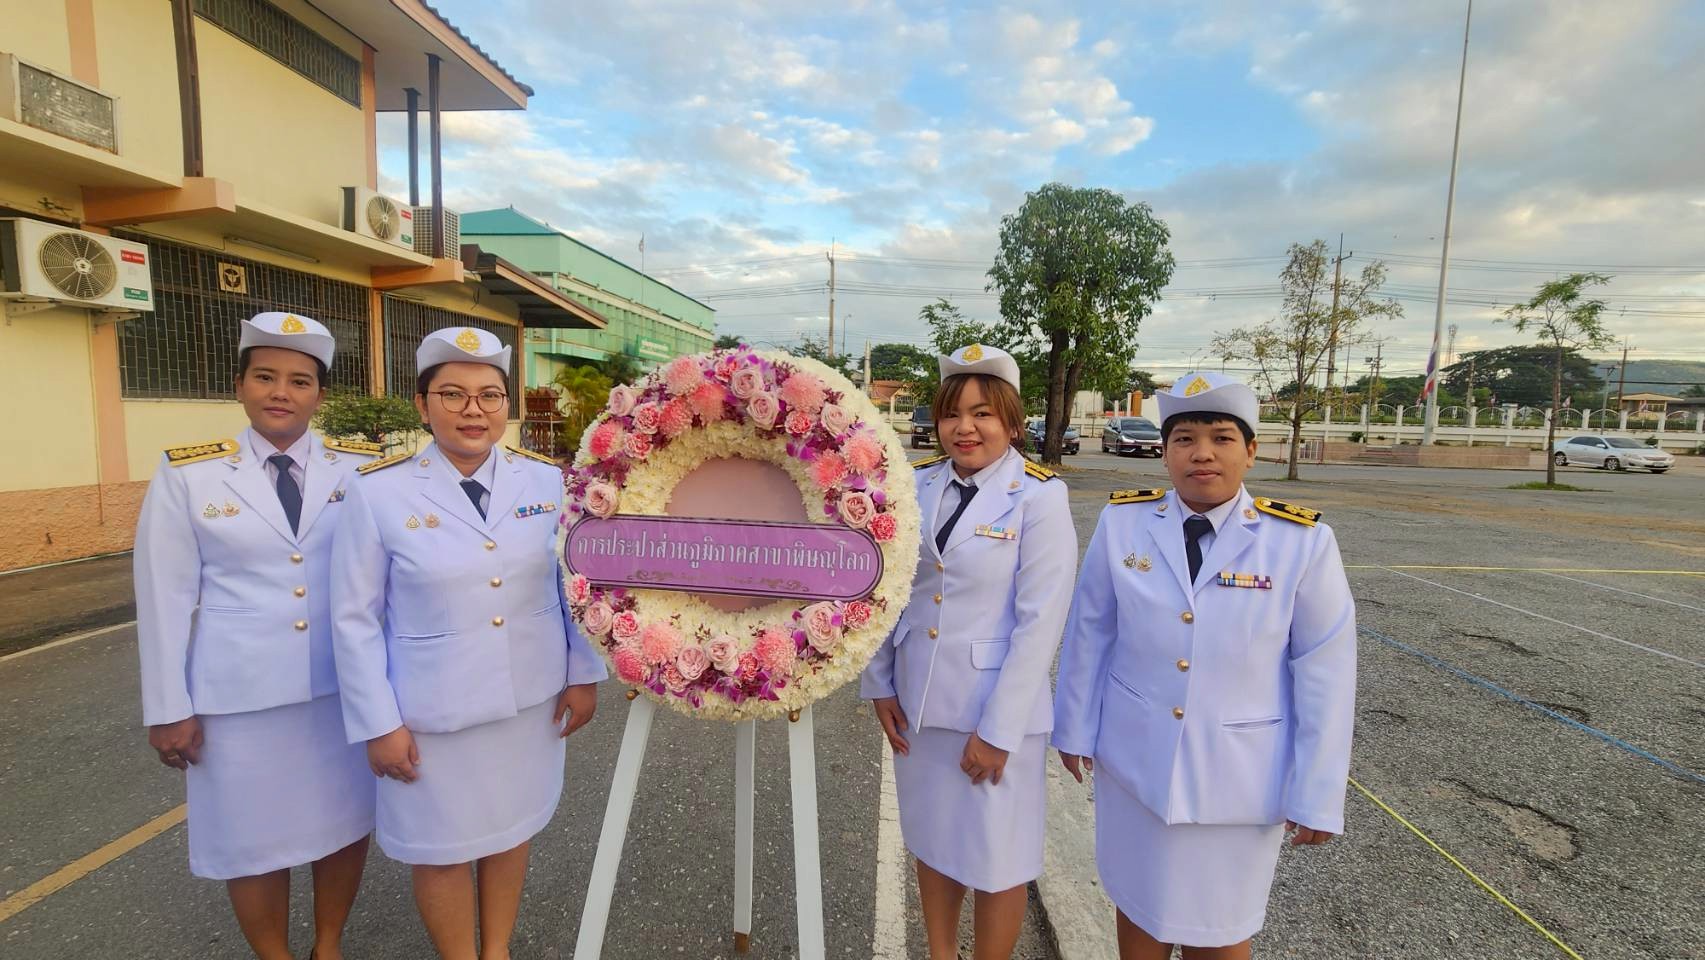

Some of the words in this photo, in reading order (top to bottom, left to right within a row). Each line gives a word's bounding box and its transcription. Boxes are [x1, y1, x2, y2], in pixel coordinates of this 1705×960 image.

[577, 529, 871, 578] การประปาส่วนภูมิภาคสาขาพิษณุโลก
